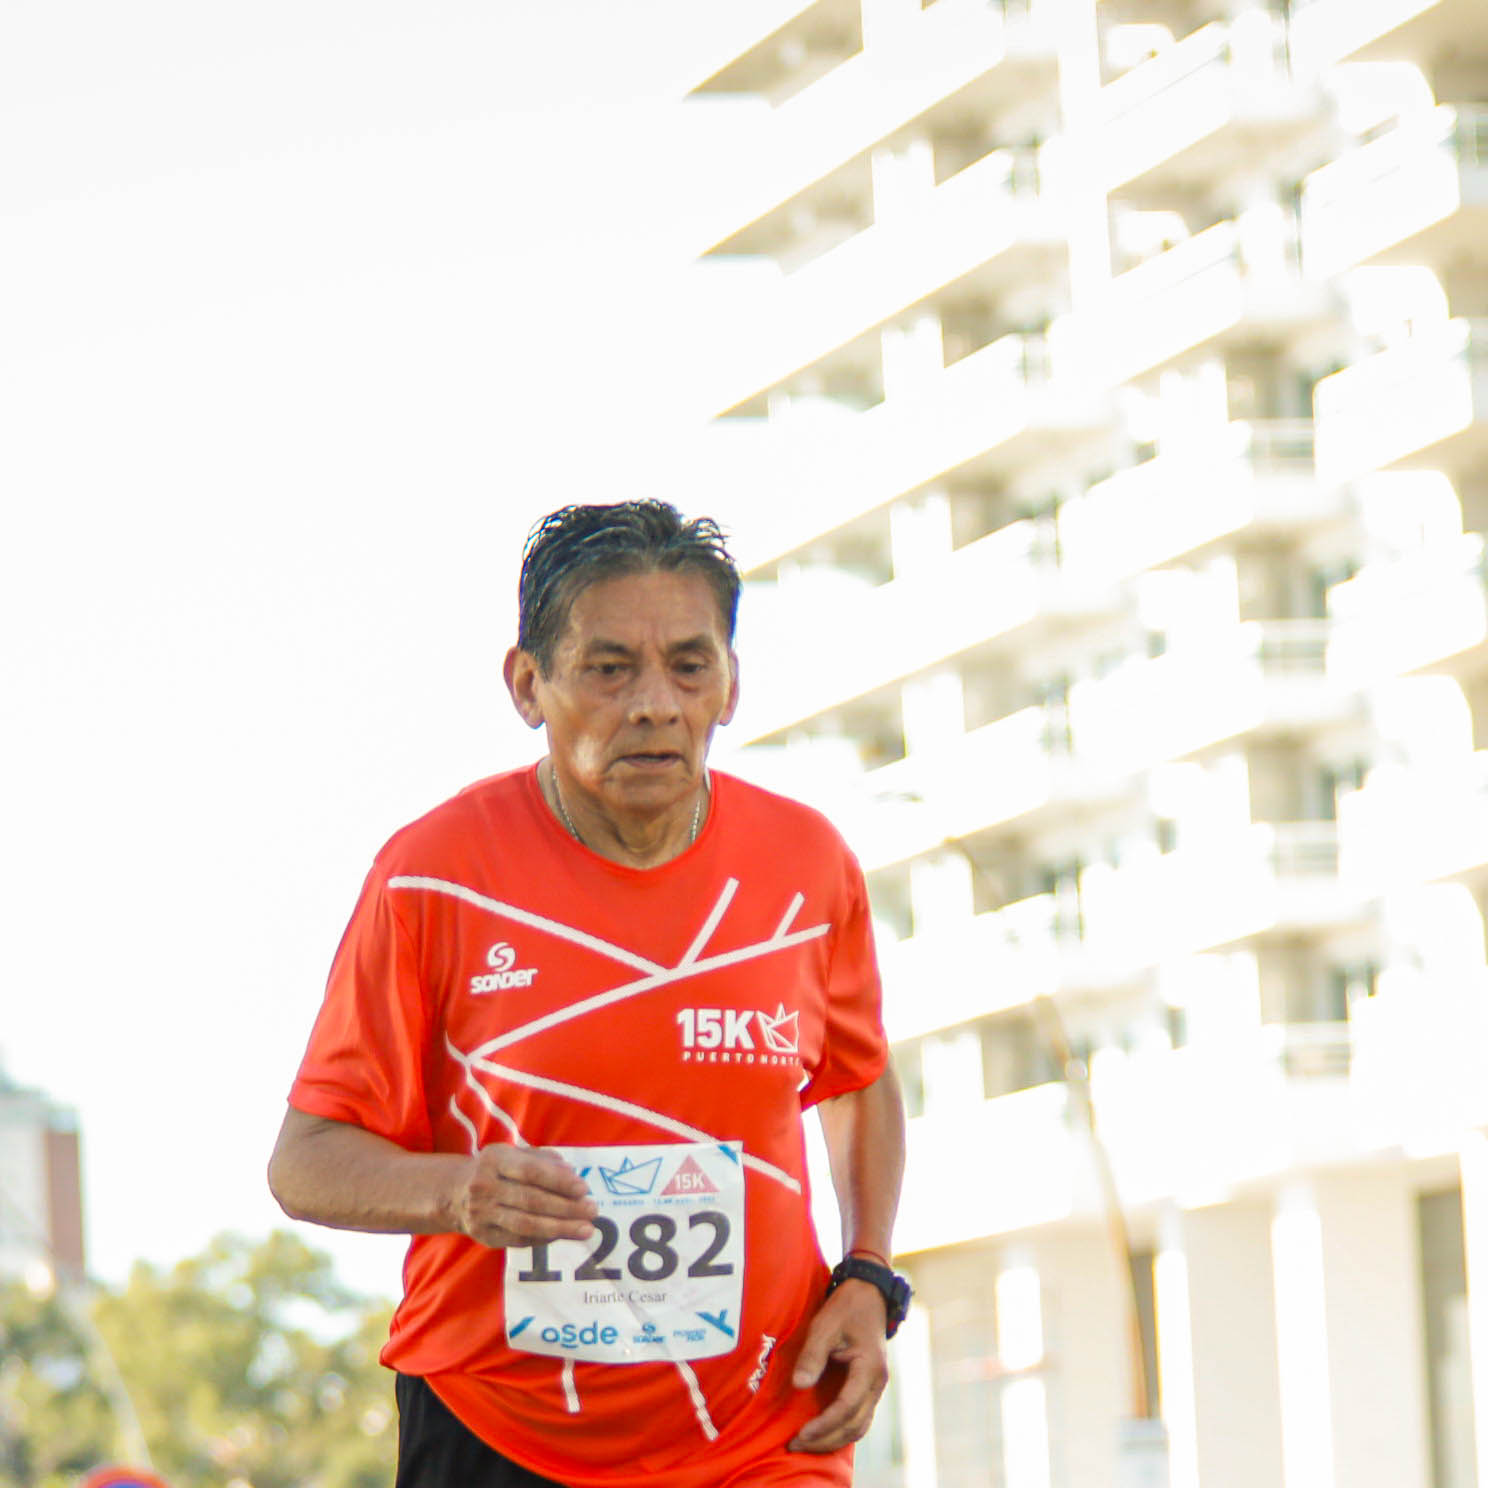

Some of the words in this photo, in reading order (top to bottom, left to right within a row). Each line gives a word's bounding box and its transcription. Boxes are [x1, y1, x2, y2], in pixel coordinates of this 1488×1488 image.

[676, 1008, 755, 1049] 15K
[682, 1051, 755, 1064] PUERTO
[674, 1172, 704, 1191] 15K
[518, 1210, 735, 1282] 1282
[541, 1320, 619, 1349] osde
